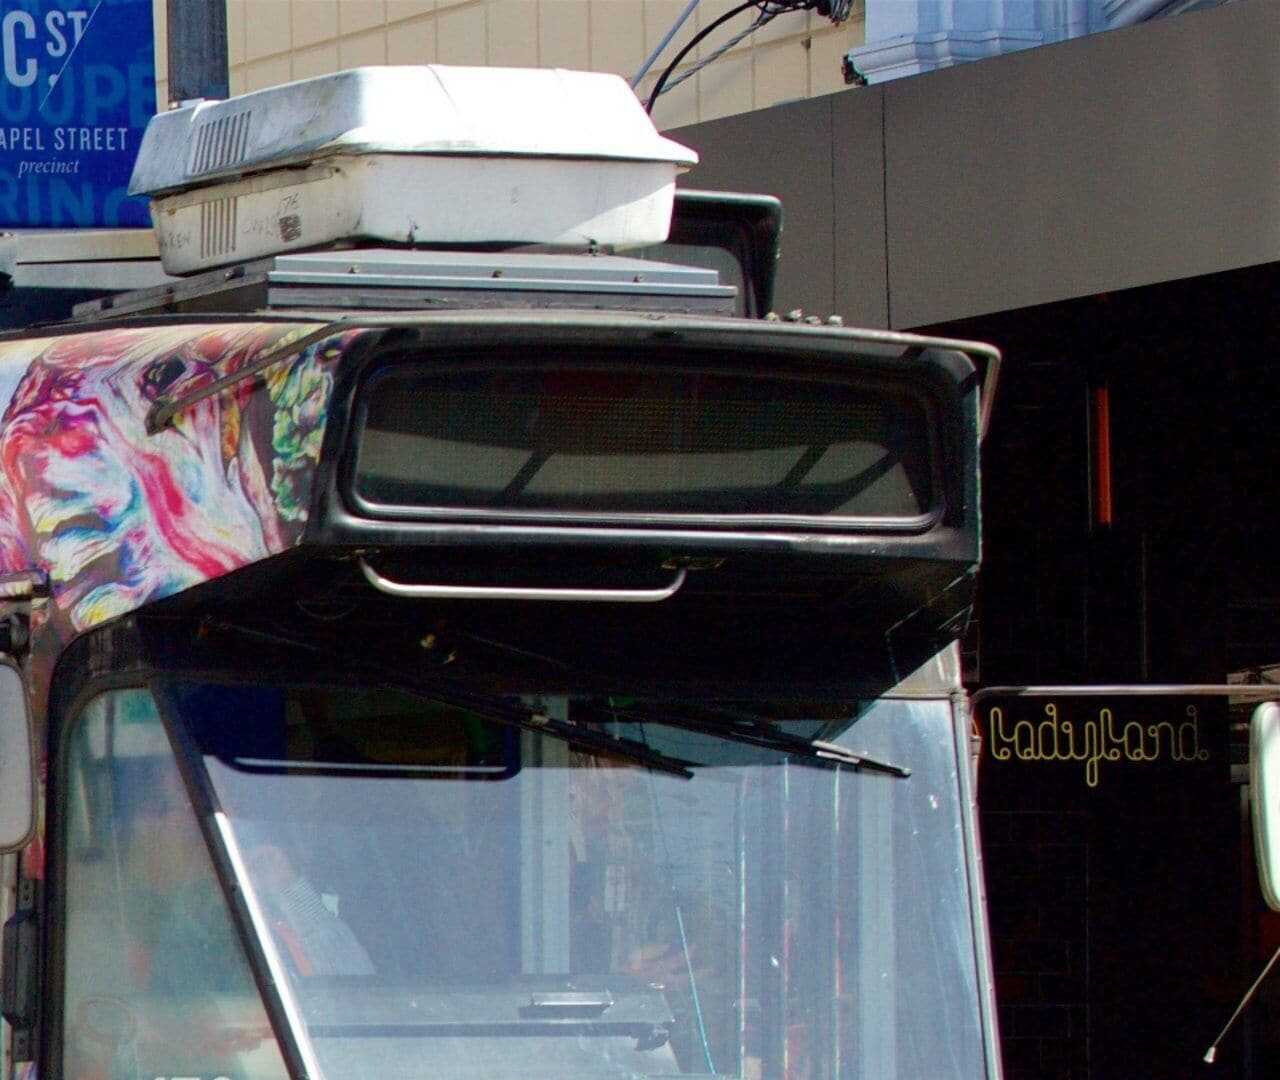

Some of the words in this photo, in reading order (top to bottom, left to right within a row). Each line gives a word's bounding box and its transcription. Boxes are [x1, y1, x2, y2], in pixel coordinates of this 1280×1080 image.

[54, 127, 128, 151] STREET
[18, 157, 80, 180] precinct
[991, 703, 1210, 787] ladyland
